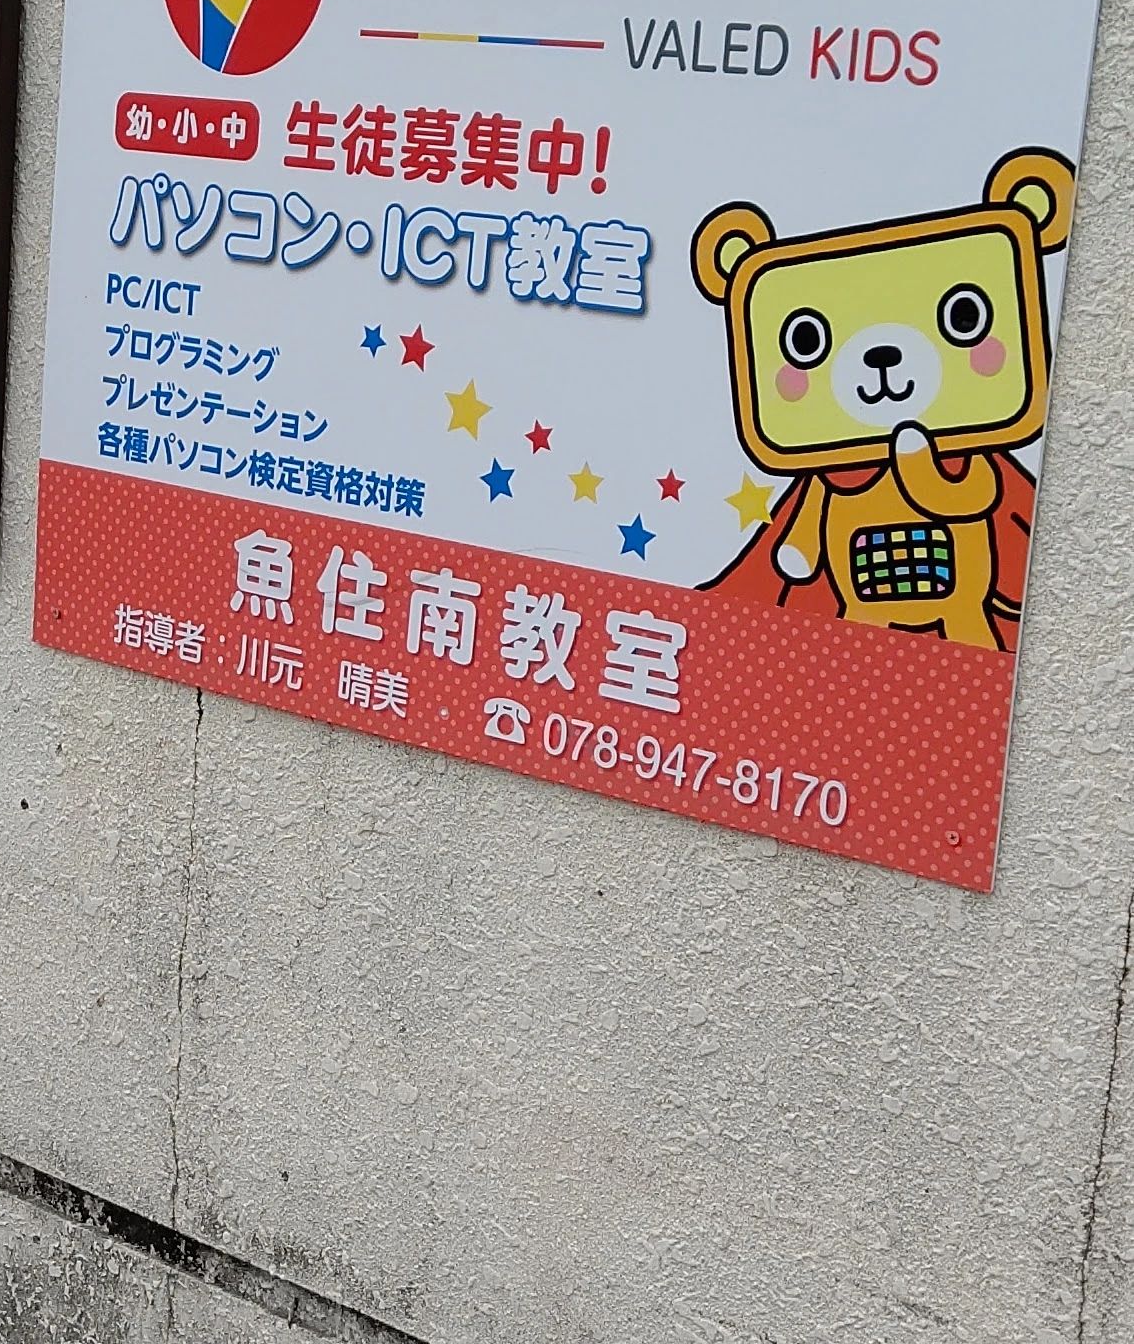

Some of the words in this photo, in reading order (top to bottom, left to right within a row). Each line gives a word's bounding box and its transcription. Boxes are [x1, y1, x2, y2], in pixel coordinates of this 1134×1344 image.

[623, 16, 791, 78] VALED
[809, 27, 942, 87] KIDS
[124, 102, 250, 151] 幼・小・中
[284, 98, 614, 195] 生徒募集中!
[109, 175, 652, 314] パソコン・ICT教室
[106, 272, 202, 317] PC/ICT
[105, 323, 281, 383] プログラミング
[102, 374, 328, 443] プレゼンテーション
[97, 421, 426, 519] 各種パソコン検定資格対策
[230, 528, 692, 717] 魚住南教室
[337, 659, 410, 721] 晴美
[542, 712, 849, 830] 078-947-8170
